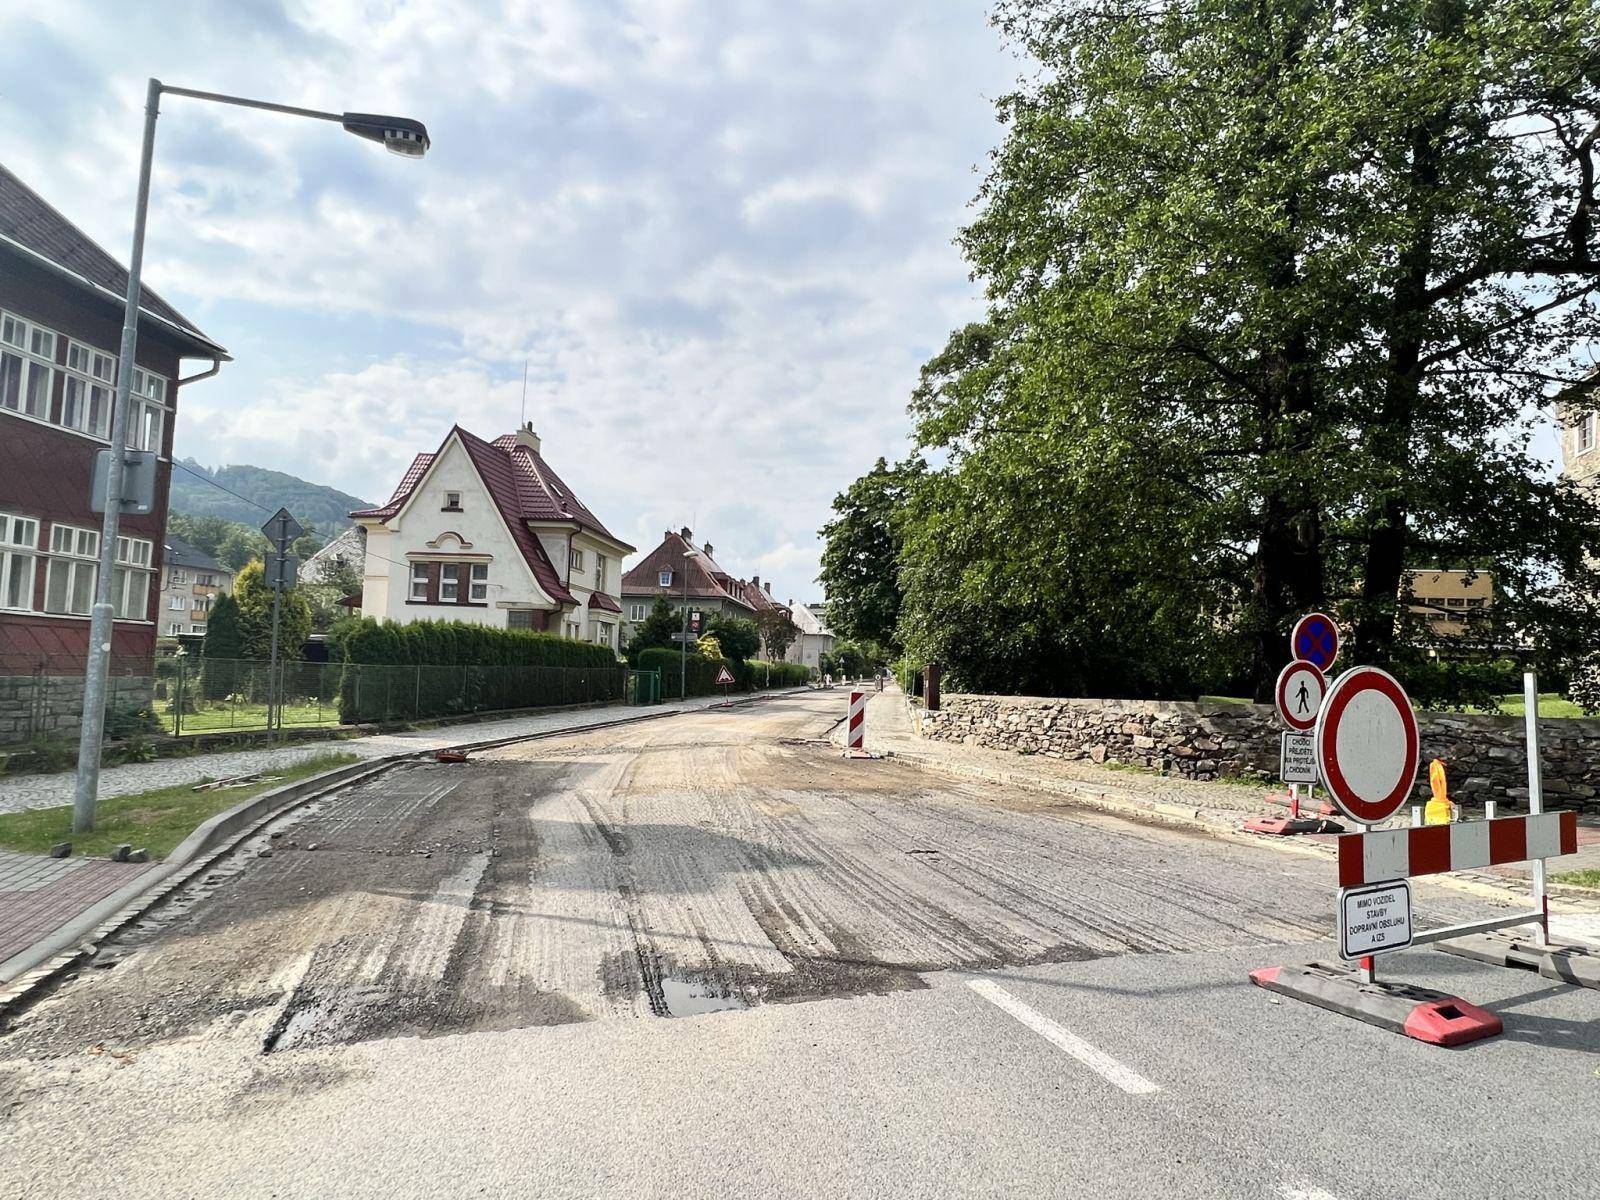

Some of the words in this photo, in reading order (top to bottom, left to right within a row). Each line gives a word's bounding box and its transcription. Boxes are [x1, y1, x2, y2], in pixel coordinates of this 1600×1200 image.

[1293, 756, 1316, 765] PROTĚJŠ
[1357, 898, 1372, 908] MIMO
[1373, 894, 1396, 905] VOZIDEL
[1366, 908, 1387, 919] STAVBY
[1379, 916, 1405, 929] OBSLUHU
[1371, 935, 1376, 943] A
[1377, 932, 1385, 942] IZS
